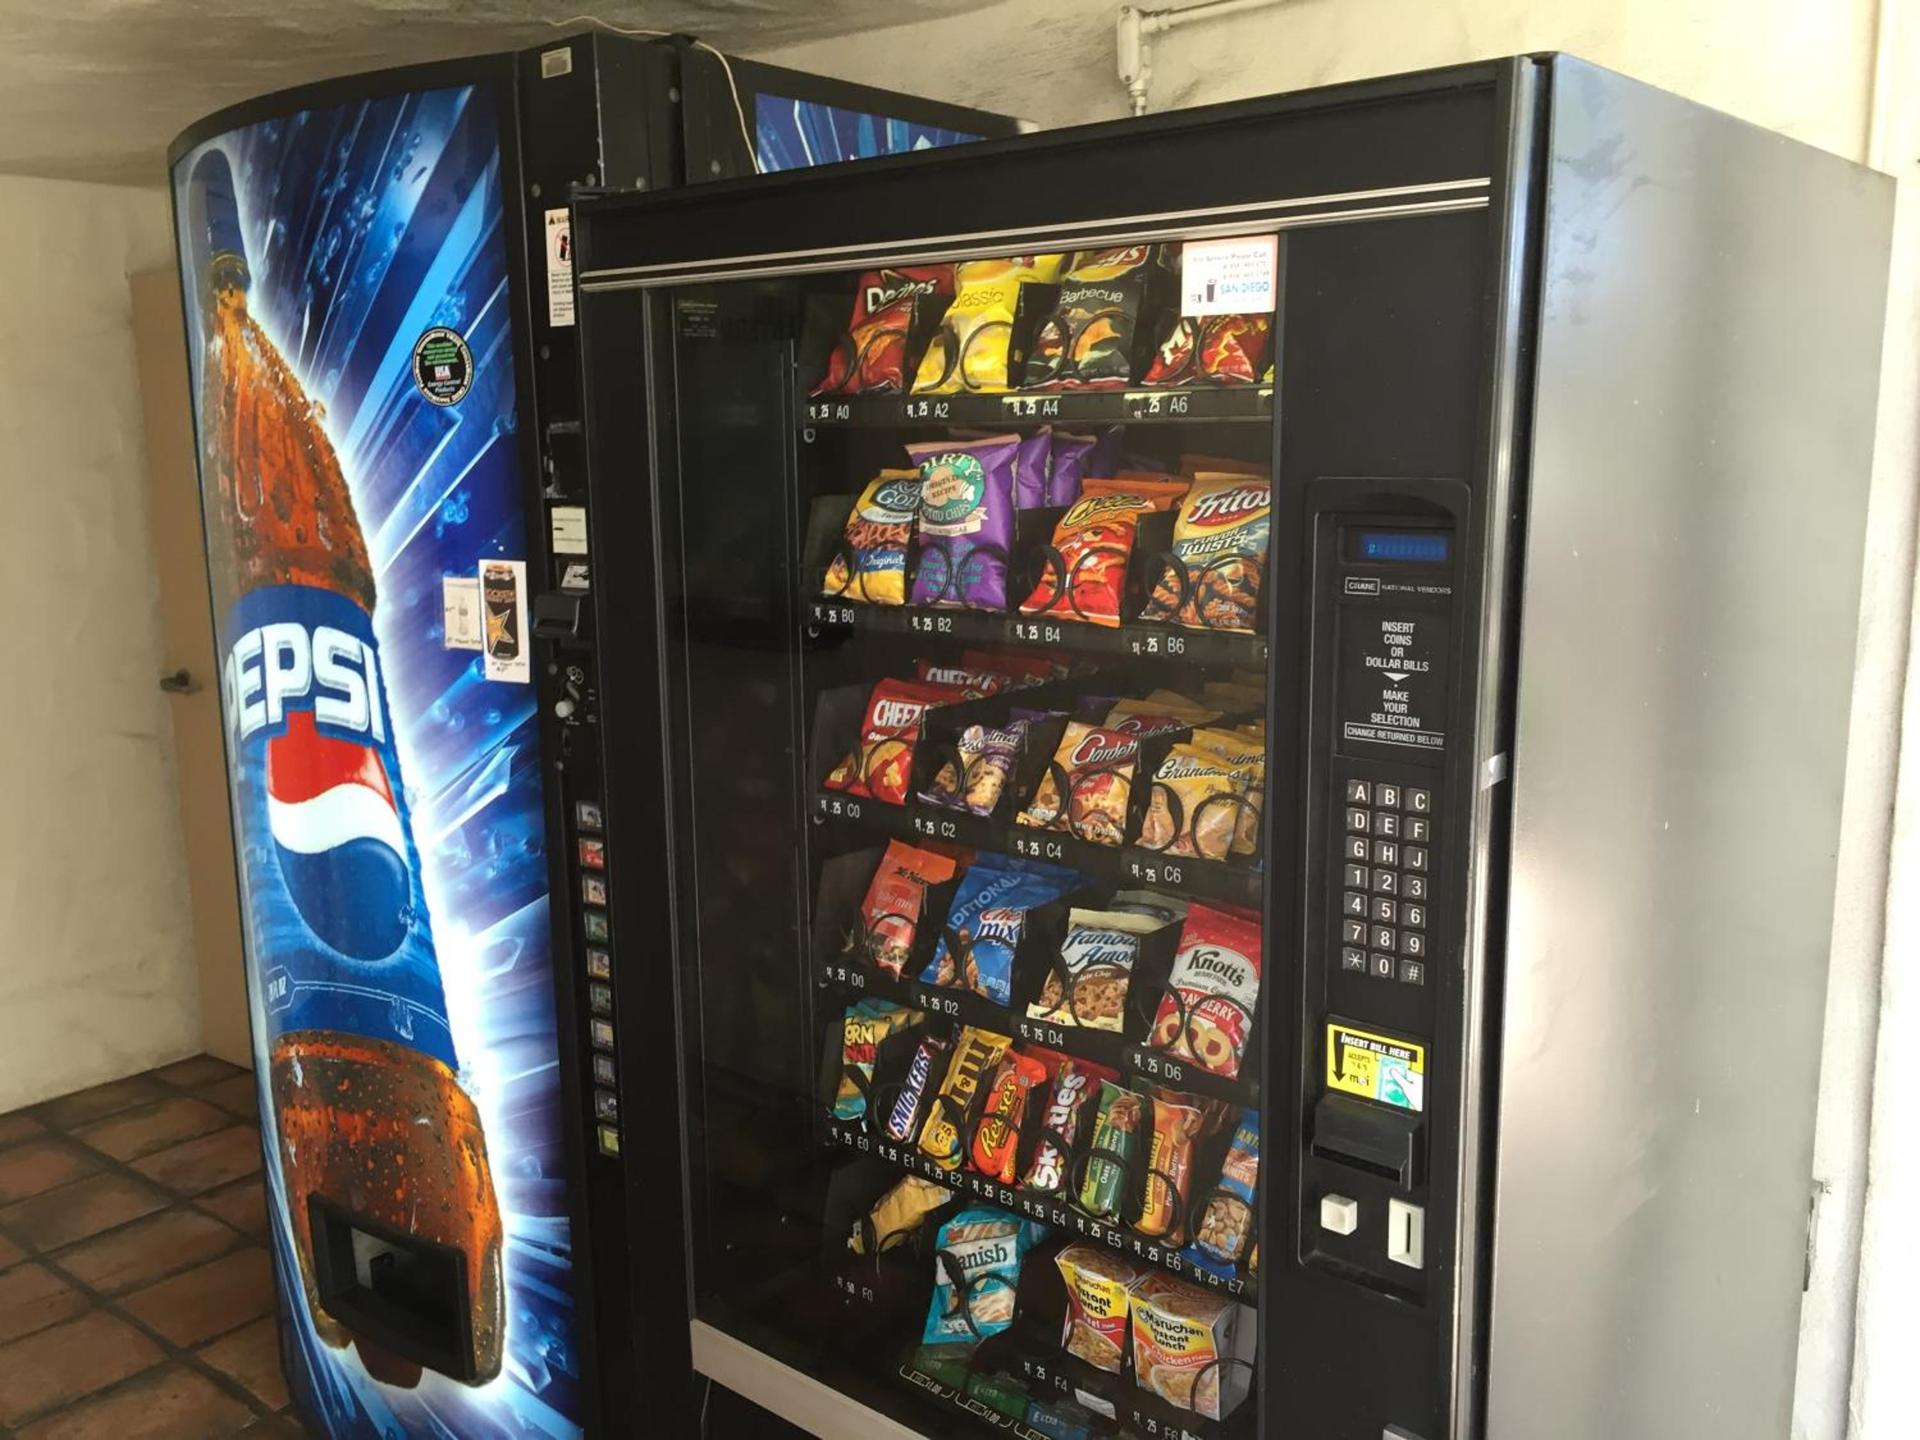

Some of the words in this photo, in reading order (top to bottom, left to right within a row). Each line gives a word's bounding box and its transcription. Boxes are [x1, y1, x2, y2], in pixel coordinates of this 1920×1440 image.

[866, 279, 939, 314] Doritos
[1060, 288, 1124, 305] Barbecue
[1187, 488, 1270, 523] Fritos
[1381, 621, 1416, 634] INSERT
[1383, 633, 1412, 646] COINS
[1390, 646, 1404, 658] OR
[1365, 656, 1401, 670] DOLLAR
[1403, 659, 1430, 672] BILLS
[1382, 689, 1410, 702] MAKE
[1383, 701, 1408, 714] YOUR
[1370, 712, 1420, 728] SELECTION
[1346, 725, 1376, 739] CHANGE
[1377, 729, 1416, 744] RETURNED
[1416, 733, 1444, 747] BELOW
[1355, 784, 1366, 801] A
[1384, 789, 1395, 805] B
[1415, 792, 1426, 811] C
[1354, 813, 1366, 829] D
[1384, 817, 1394, 835] E
[1413, 822, 1424, 839] F
[1353, 840, 1364, 858] G
[1382, 846, 1393, 863] H
[1412, 851, 1422, 868] J
[1353, 869, 1361, 886] 1
[1381, 874, 1392, 891] 2
[1411, 879, 1422, 896] 3
[1351, 897, 1362, 912] 4
[1381, 902, 1391, 919] 5
[1410, 907, 1421, 925] 6
[1351, 925, 1361, 940] 7
[1380, 930, 1390, 947] 8
[1409, 936, 1420, 954] 9
[1187, 949, 1245, 987] Knott's
[1379, 958, 1389, 975] 0
[1369, 1041, 1388, 1055] BILL
[1388, 1046, 1412, 1060] HERE
[960, 1243, 1008, 1271] anish
[1145, 1310, 1205, 1338] Maruchan
[1154, 1334, 1186, 1351] Lunch
